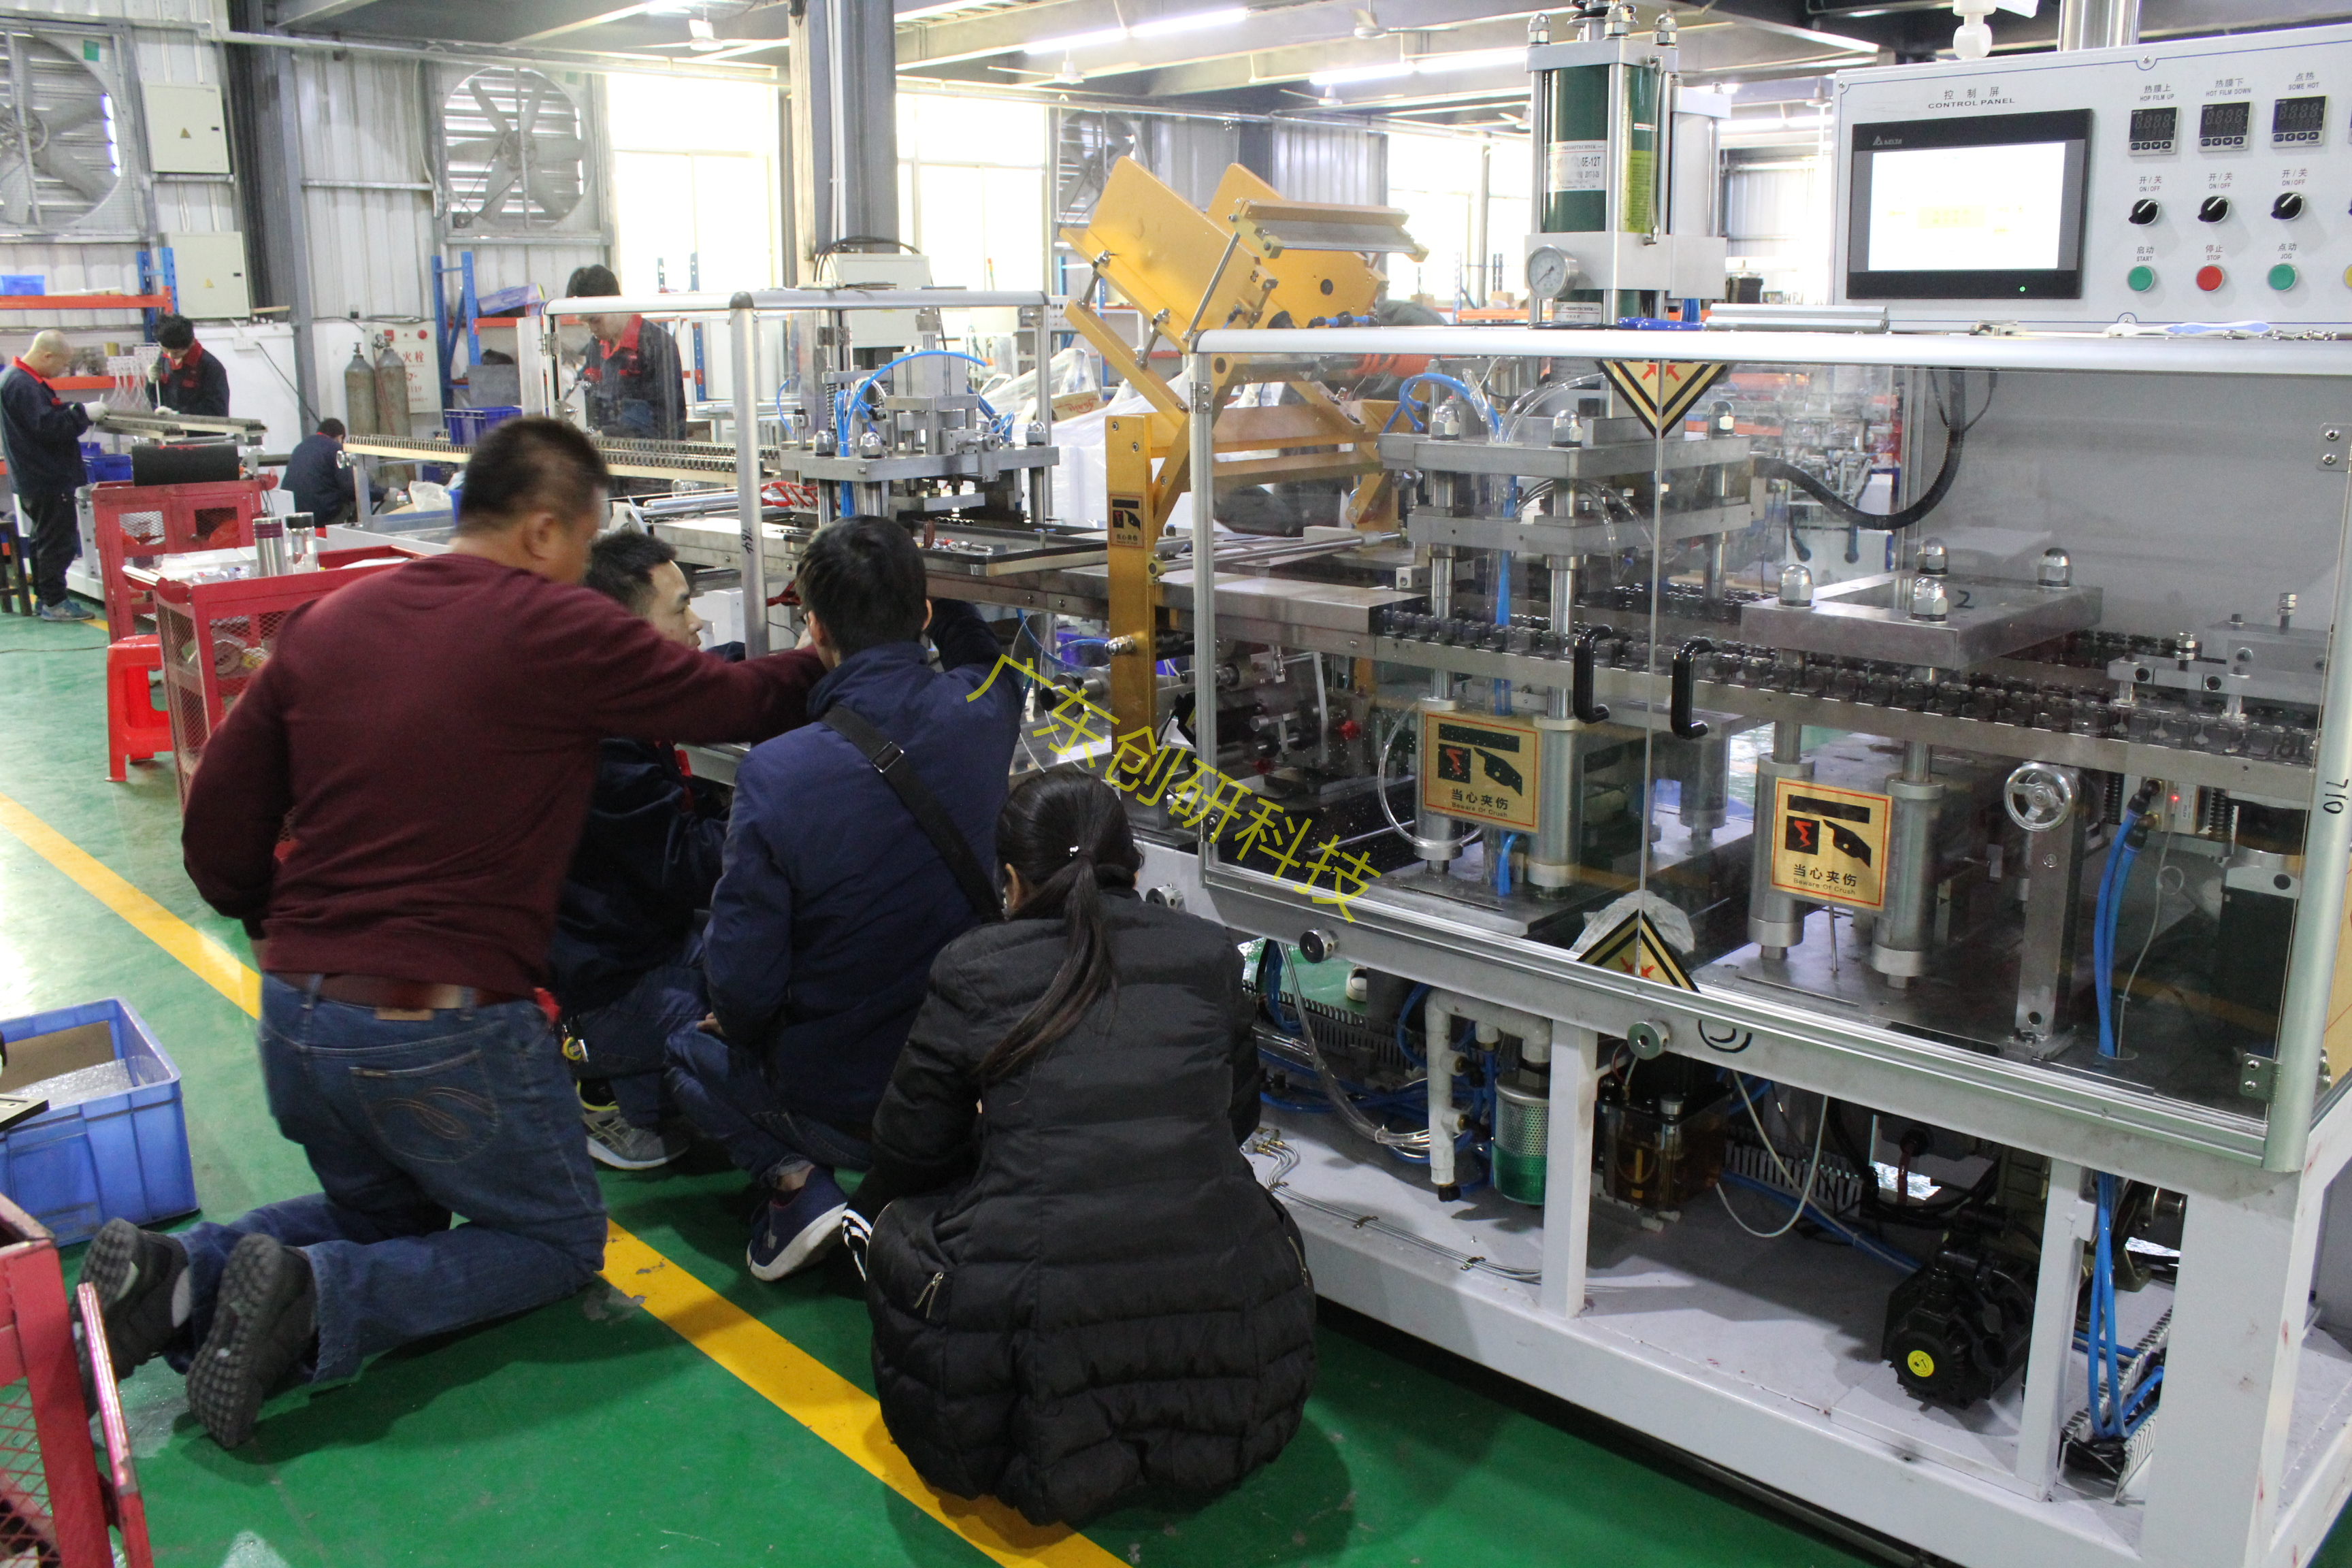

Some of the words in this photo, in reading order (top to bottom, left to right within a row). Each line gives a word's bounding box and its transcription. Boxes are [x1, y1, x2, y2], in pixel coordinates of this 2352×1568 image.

[1944, 86, 1999, 101] 控制屏
[1928, 100, 1978, 109] CONTROL
[2136, 246, 2154, 254] 启动
[2206, 244, 2223, 252] 停止
[2278, 242, 2297, 252] 点动
[1452, 789, 1509, 810] 当心夹伤
[2323, 778, 2349, 815] 710
[1452, 802, 1475, 811] Beware
[1488, 809, 1507, 817] Crush
[1793, 864, 1857, 887] 当心夹伤
[1793, 878, 1820, 888] Beware
[1834, 886, 1856, 896] Crush
